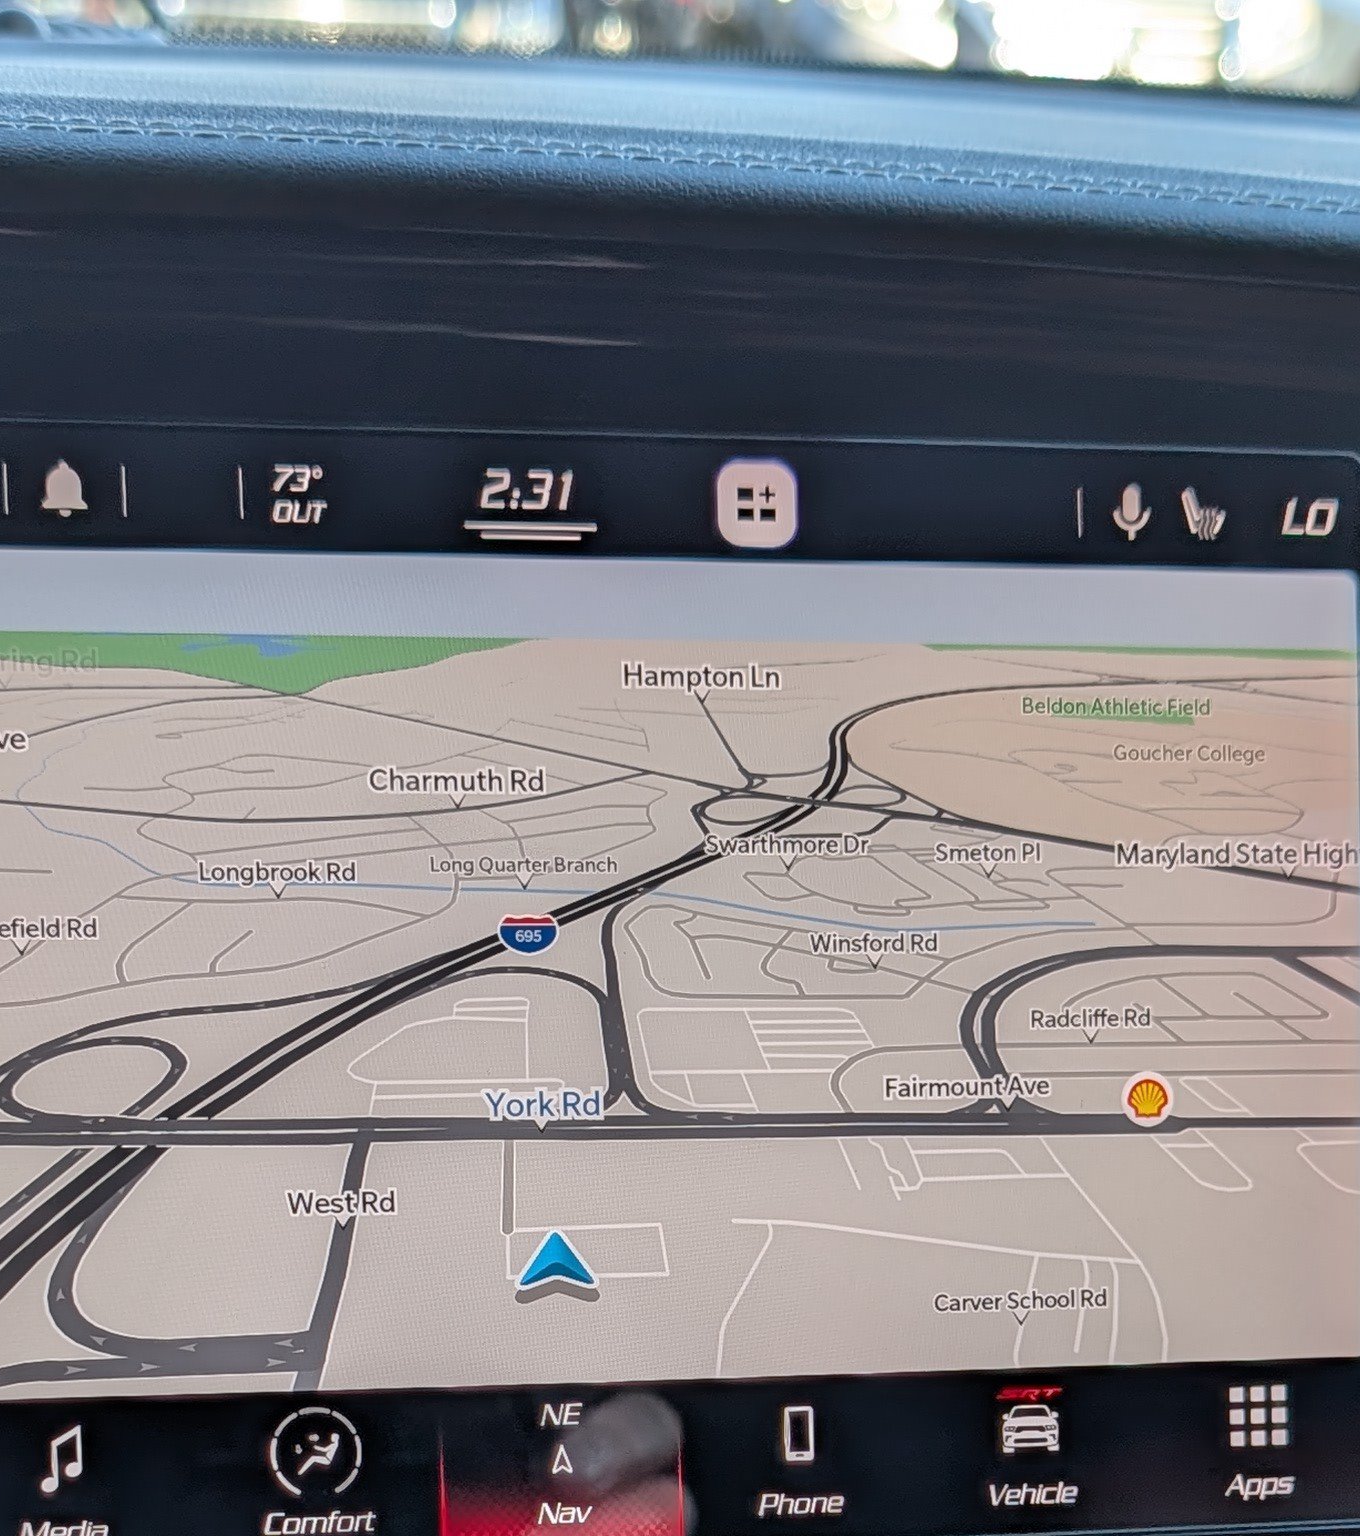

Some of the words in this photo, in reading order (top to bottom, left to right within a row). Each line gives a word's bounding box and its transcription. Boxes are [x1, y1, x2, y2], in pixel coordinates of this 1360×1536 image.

[480, 467, 574, 511] 2:31
[272, 501, 327, 524] OUT
[1281, 498, 1339, 536] LO
[61, 648, 97, 672] Rd
[623, 664, 744, 692] Hampton
[750, 665, 781, 688] Ln
[1022, 696, 1087, 716] Beldon
[1092, 696, 1163, 716] Athletic
[1167, 698, 1211, 716] Field
[1114, 744, 1193, 763] Goucher
[1197, 744, 1266, 766] College
[369, 768, 503, 793] Charmuth
[510, 769, 545, 793] Rd
[706, 833, 838, 854] Swarthmore
[844, 835, 869, 853] Dr
[935, 844, 1016, 862] Smeton
[1021, 843, 1041, 862] Pl
[1116, 842, 1230, 869] Maryland
[1236, 842, 1297, 864] State
[1303, 842, 1358, 867] High
[199, 861, 320, 887] Longbrook
[326, 861, 356, 884] Rd
[430, 857, 474, 877] Long
[478, 856, 548, 876] Quarter
[553, 856, 617, 874] Branch
[67, 918, 97, 938] Rd
[514, 929, 542, 945] 695
[811, 933, 904, 953] Winsford
[910, 933, 938, 953] Rd
[1031, 1009, 1119, 1029] Radcliffe
[1124, 1009, 1151, 1027] Rd
[885, 1077, 1003, 1098] Fairmount
[1008, 1077, 1049, 1096] Ave
[485, 1091, 555, 1118] York
[562, 1091, 600, 1116] Rd
[288, 1192, 355, 1215] West
[361, 1191, 396, 1214] Rd
[935, 1293, 1001, 1312] Carver
[1007, 1290, 1073, 1311] School
[1079, 1288, 1108, 1309] Rd
[540, 1403, 582, 1426] NE
[989, 1481, 1078, 1507] Vehicle
[1225, 1472, 1295, 1500] Apps
[537, 1501, 592, 1526] Nav
[758, 1490, 844, 1517] Phone
[263, 1510, 376, 1536] Comfort
